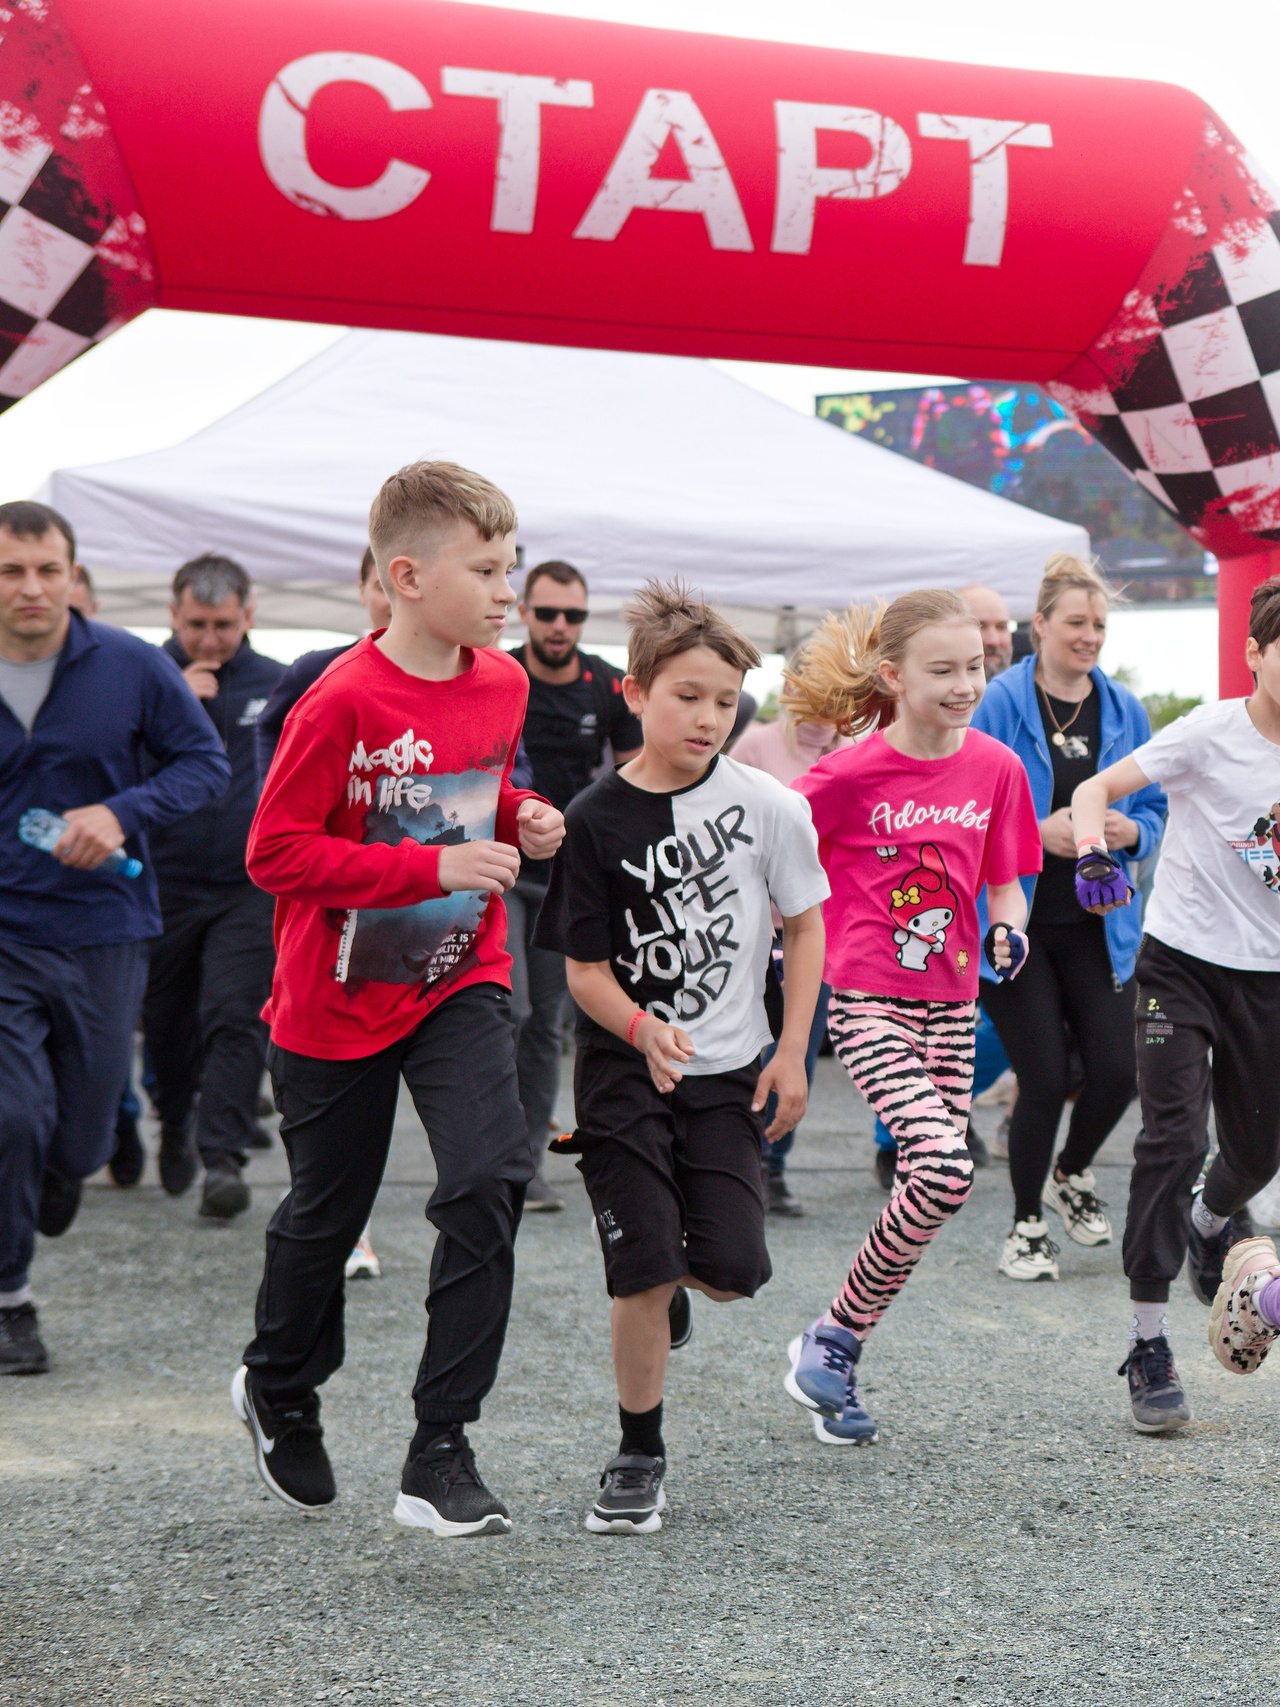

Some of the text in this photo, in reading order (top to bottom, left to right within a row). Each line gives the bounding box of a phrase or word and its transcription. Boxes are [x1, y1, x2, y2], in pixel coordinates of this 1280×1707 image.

[258, 51, 1053, 268] СТАРТ
[349, 728, 434, 775] Magic
[347, 774, 433, 815] in life
[621, 805, 754, 894] YOUR
[625, 860, 739, 949] LIFE
[616, 913, 740, 985] YOUR
[635, 960, 733, 1024] OOD
